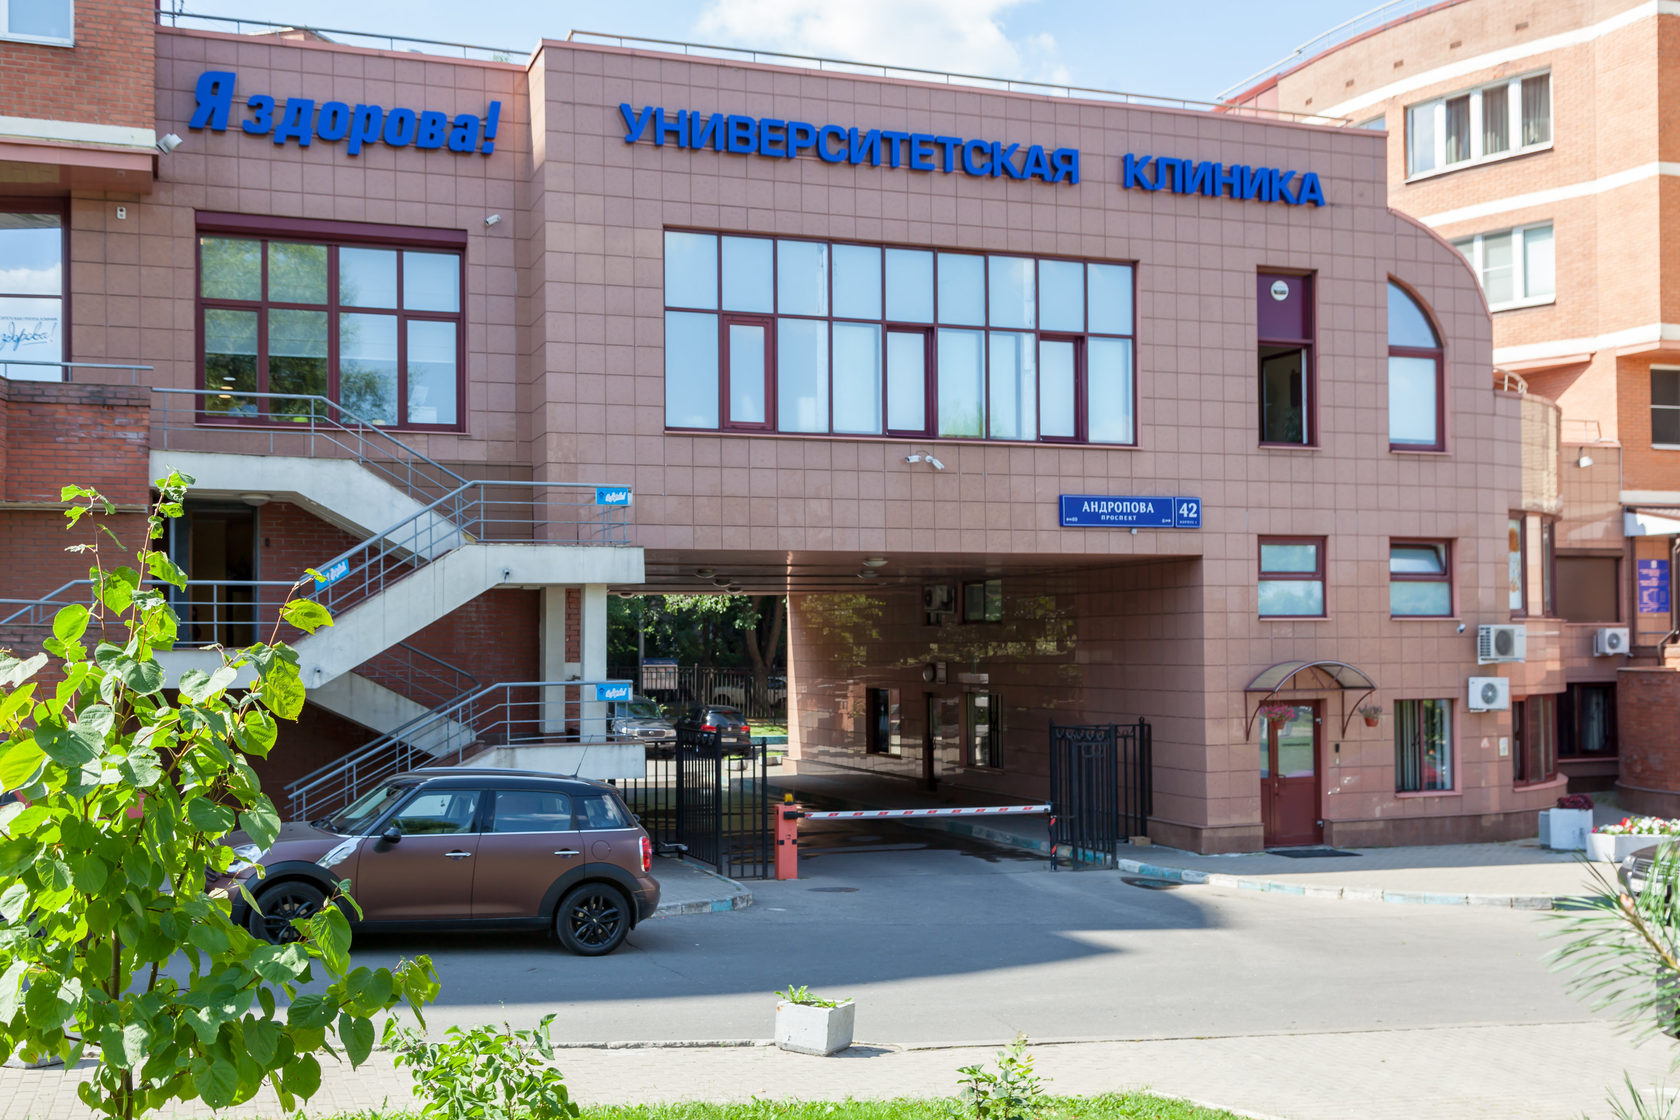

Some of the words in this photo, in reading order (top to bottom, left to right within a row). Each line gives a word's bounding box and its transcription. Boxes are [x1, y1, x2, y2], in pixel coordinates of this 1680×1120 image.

[189, 71, 236, 130] Я
[242, 94, 501, 155] здорова!
[620, 102, 1080, 184] УНИВЕРСИТЕТСКАЯ
[1123, 153, 1325, 207] КЛИНИКА
[1082, 501, 1155, 514] АНДРОПОВА
[1179, 502, 1198, 518] 42
